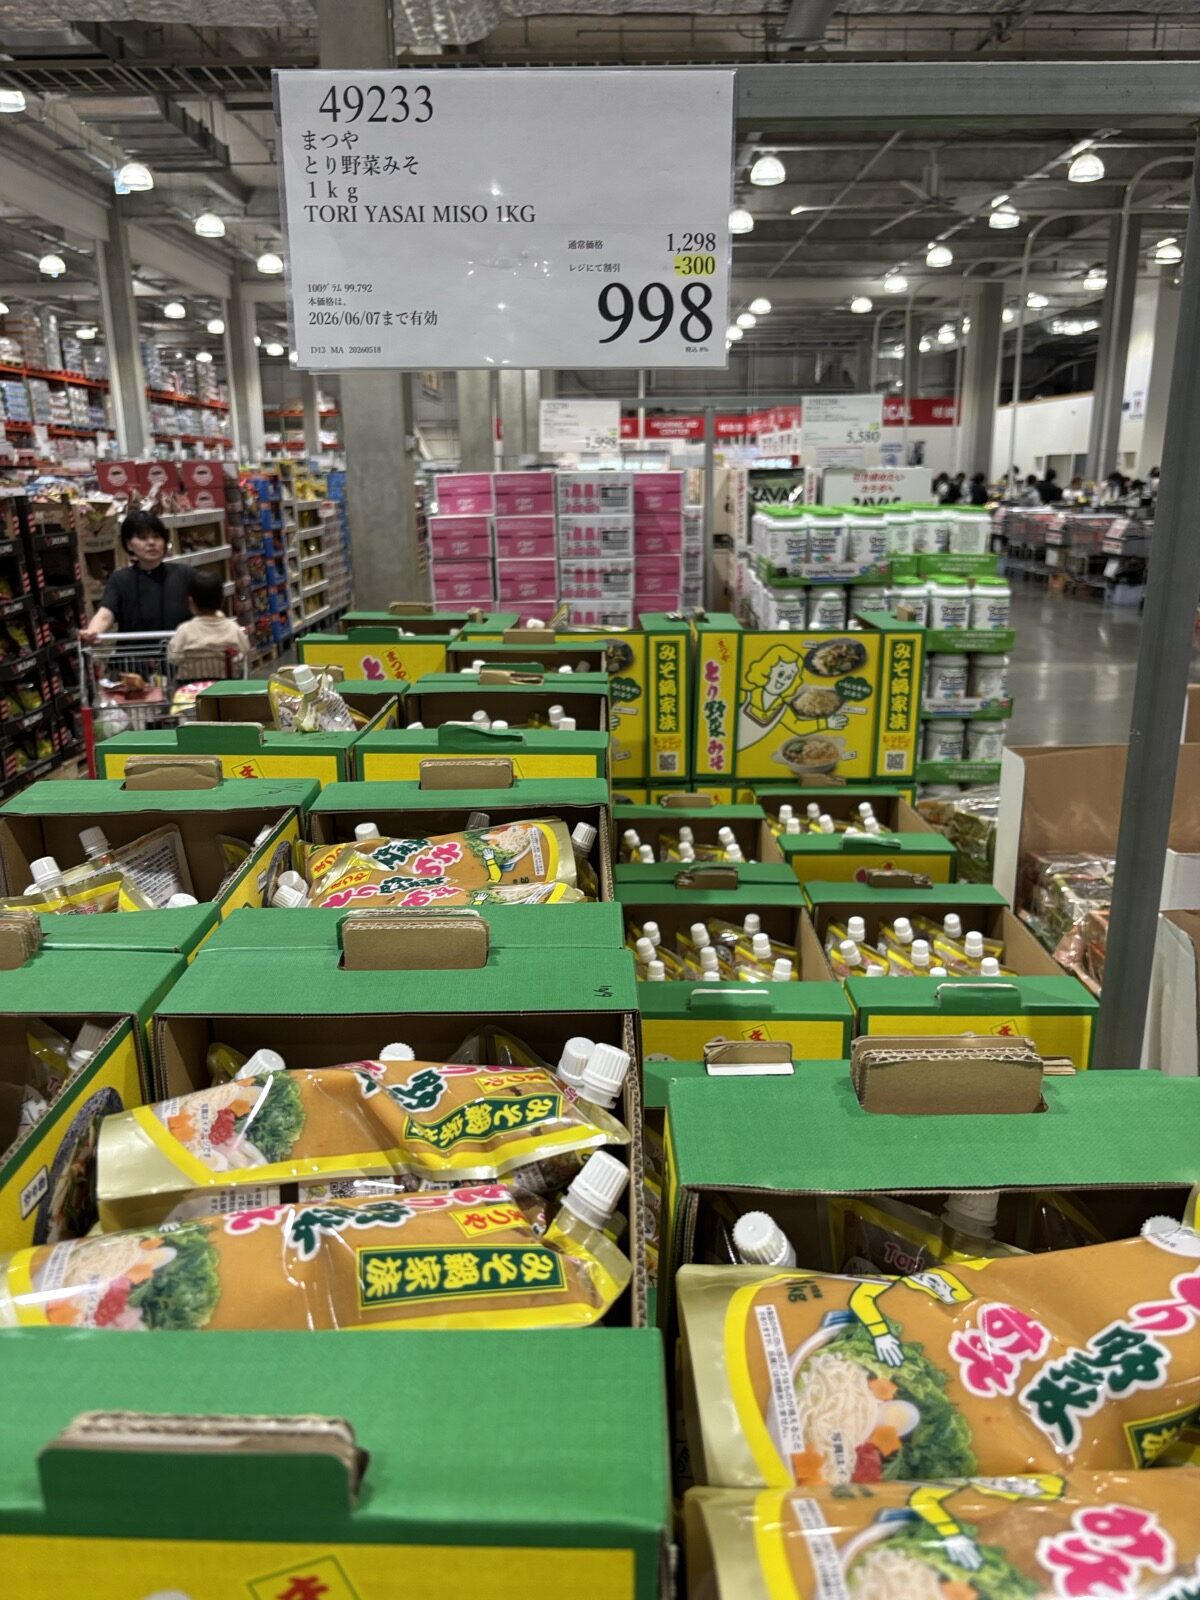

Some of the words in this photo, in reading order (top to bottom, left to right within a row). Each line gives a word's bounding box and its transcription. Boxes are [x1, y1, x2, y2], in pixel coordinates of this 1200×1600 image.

[319, 85, 434, 123] 49233
[301, 130, 359, 150] まつや
[304, 154, 419, 176] とり野菜みそ
[304, 205, 357, 223] TORI
[364, 205, 424, 223] YASAI
[433, 205, 488, 223] MISO
[496, 204, 536, 223] 1KG
[568, 240, 604, 250] 通常価格
[666, 232, 716, 254] 1,298
[569, 263, 621, 273] レジにて割引
[674, 256, 716, 275] -300
[344, 283, 373, 293] 99.792
[308, 310, 438, 326] 2026/06/07まで有効
[597, 282, 713, 344] 998
[310, 346, 326, 354] D13
[331, 346, 344, 354] MA
[348, 346, 382, 354] 20260518
[703, 660, 726, 771] とり野菜みそ
[365, 1252, 554, 1298] みそ鍋家族
